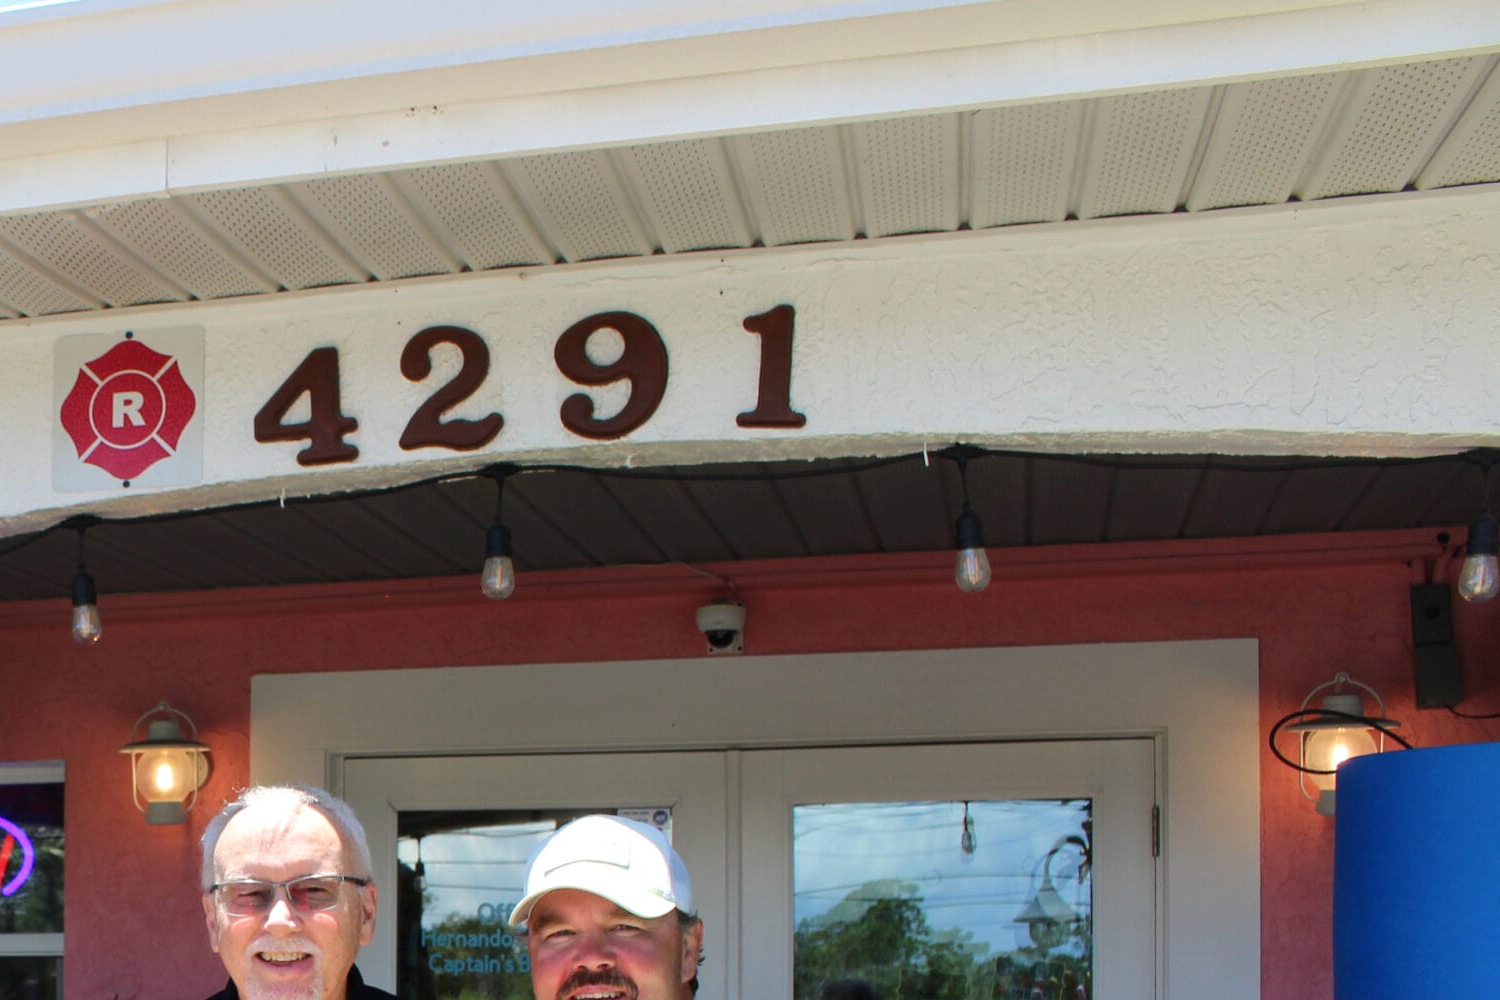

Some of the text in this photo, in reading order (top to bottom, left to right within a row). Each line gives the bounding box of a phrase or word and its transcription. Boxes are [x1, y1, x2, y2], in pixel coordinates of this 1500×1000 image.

[253, 303, 807, 467] 4291
[111, 390, 146, 429] R
[421, 927, 514, 948] Hernando
[428, 952, 515, 977] Captain's
